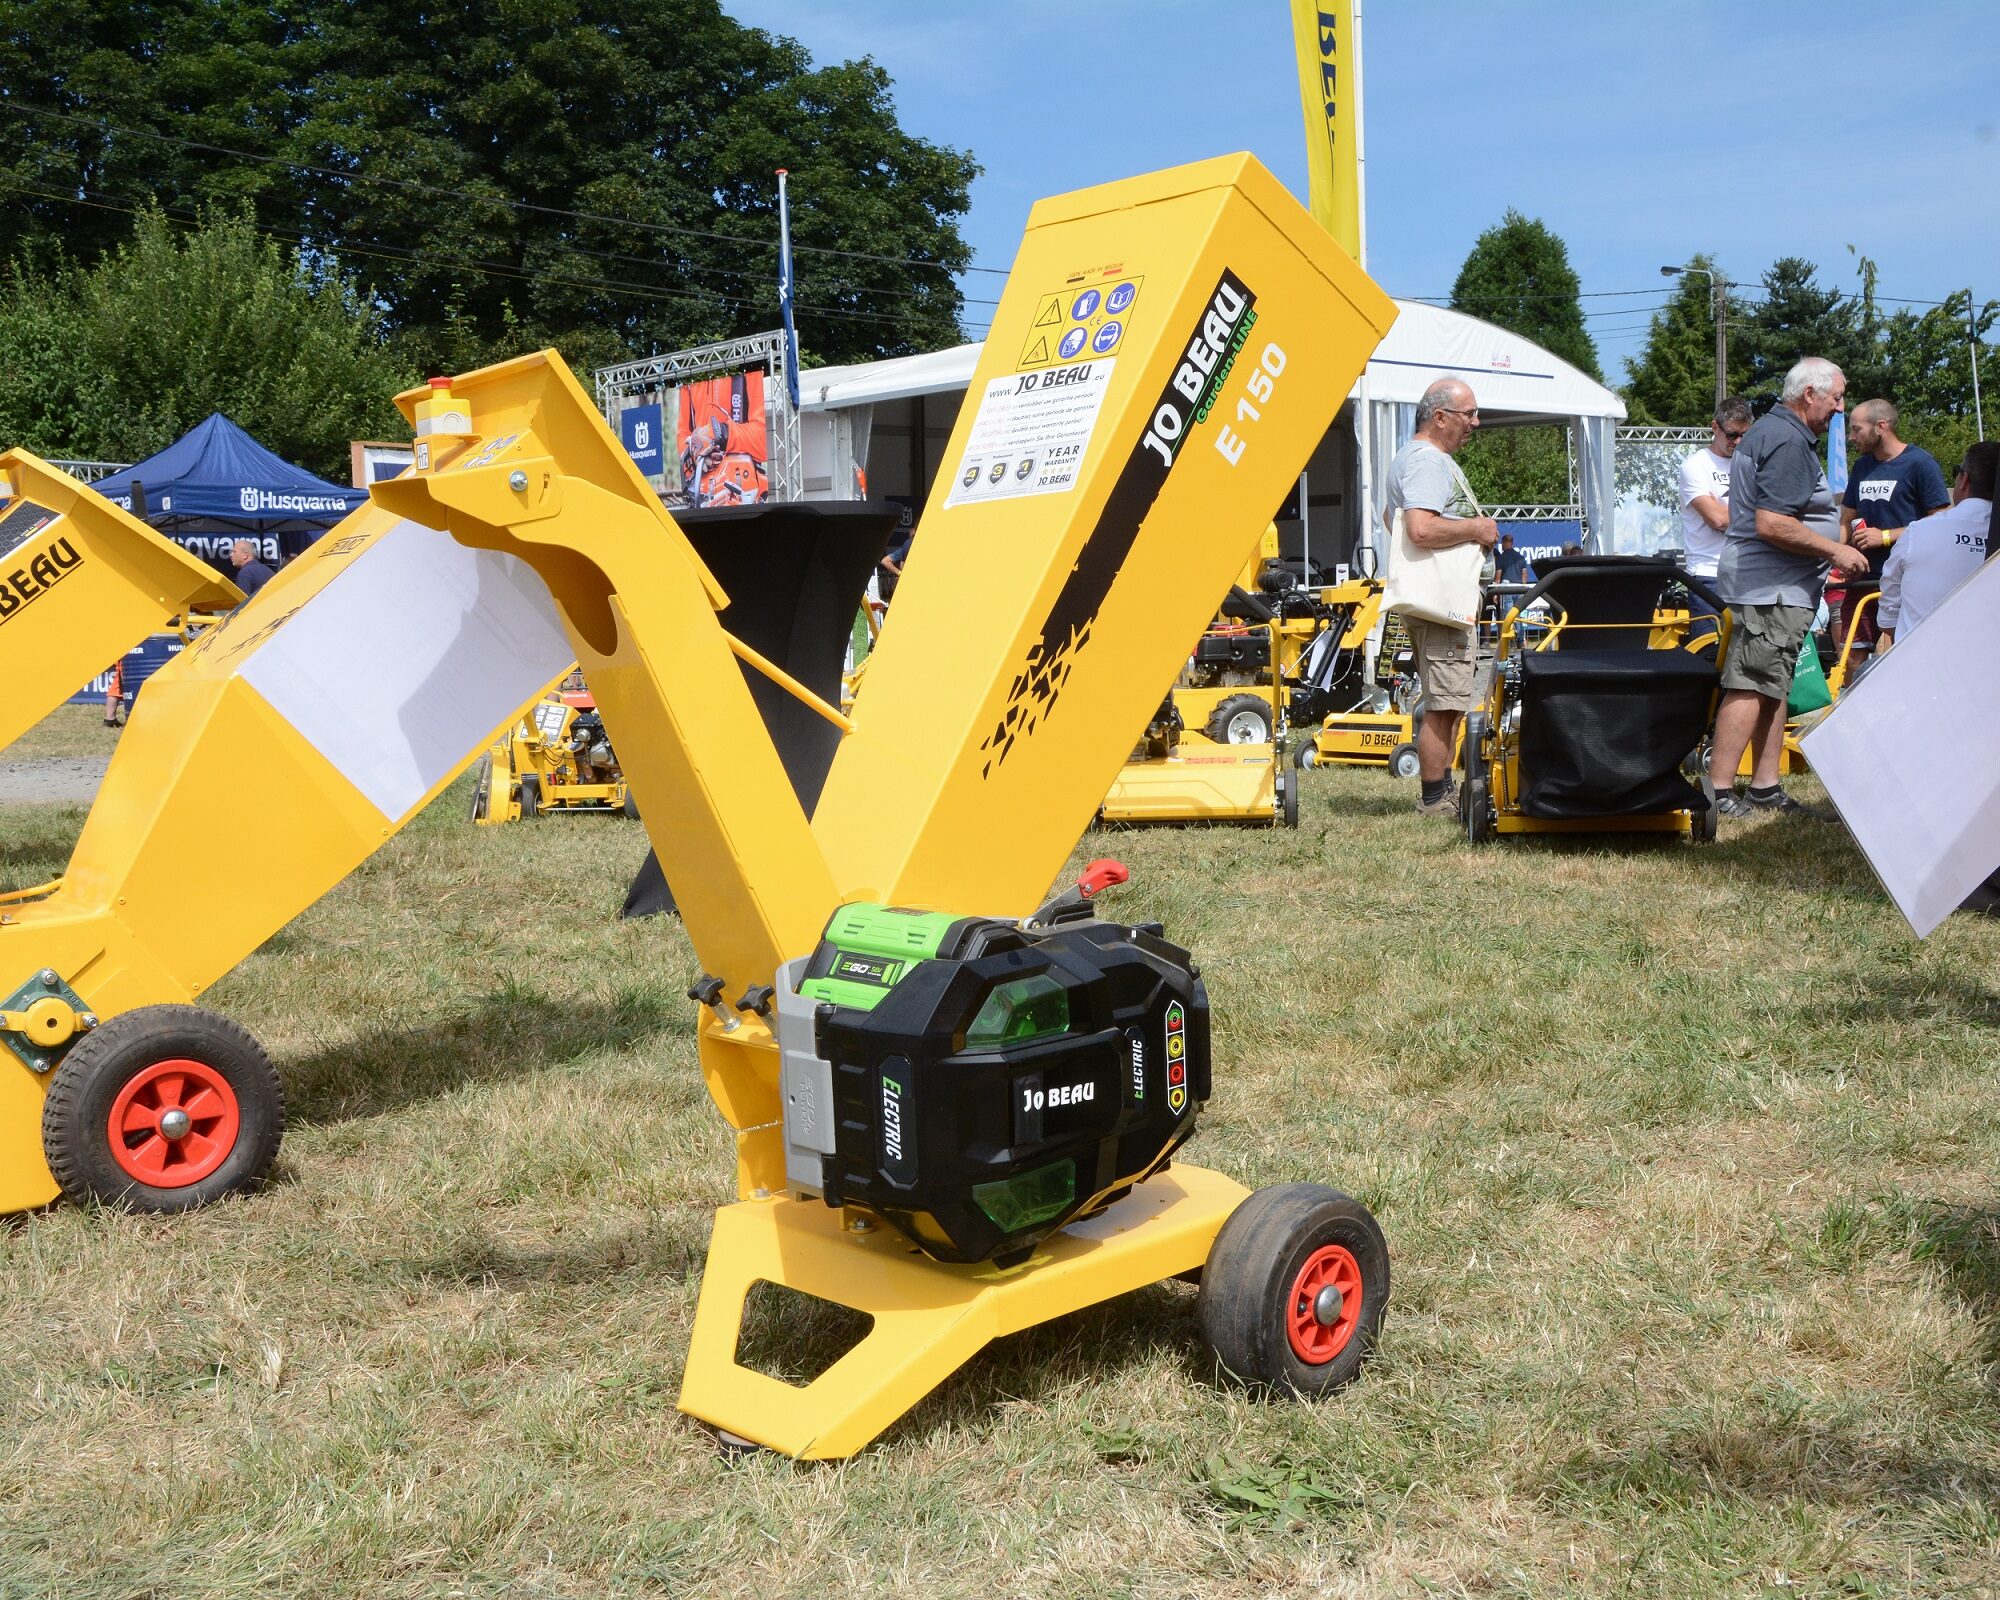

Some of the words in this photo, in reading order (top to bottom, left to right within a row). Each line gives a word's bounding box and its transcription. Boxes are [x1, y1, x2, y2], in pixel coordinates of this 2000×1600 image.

[1143, 403, 1182, 467] JO
[1173, 282, 1246, 404] BEAU
[1196, 309, 1258, 424] Garden-LINE
[1014, 374, 1039, 396] JO
[1042, 364, 1092, 388] BEAU
[1214, 424, 1246, 467] E
[1237, 342, 1287, 423] 150
[1044, 457, 1077, 466] WARRANTY
[1048, 445, 1080, 458] YEAR
[993, 465, 1004, 476] 3
[259, 491, 347, 513] Husqvarna
[1955, 534, 1971, 545] JO
[1448, 610, 1465, 621] ING
[1360, 733, 1372, 747] JO
[1374, 734, 1400, 746] BEAU
[841, 961, 869, 974] EGO
[1132, 1039, 1144, 1100] ELECTRIC
[1049, 1082, 1095, 1108] BEAU
[882, 1075, 902, 1161] ELECTRIC
